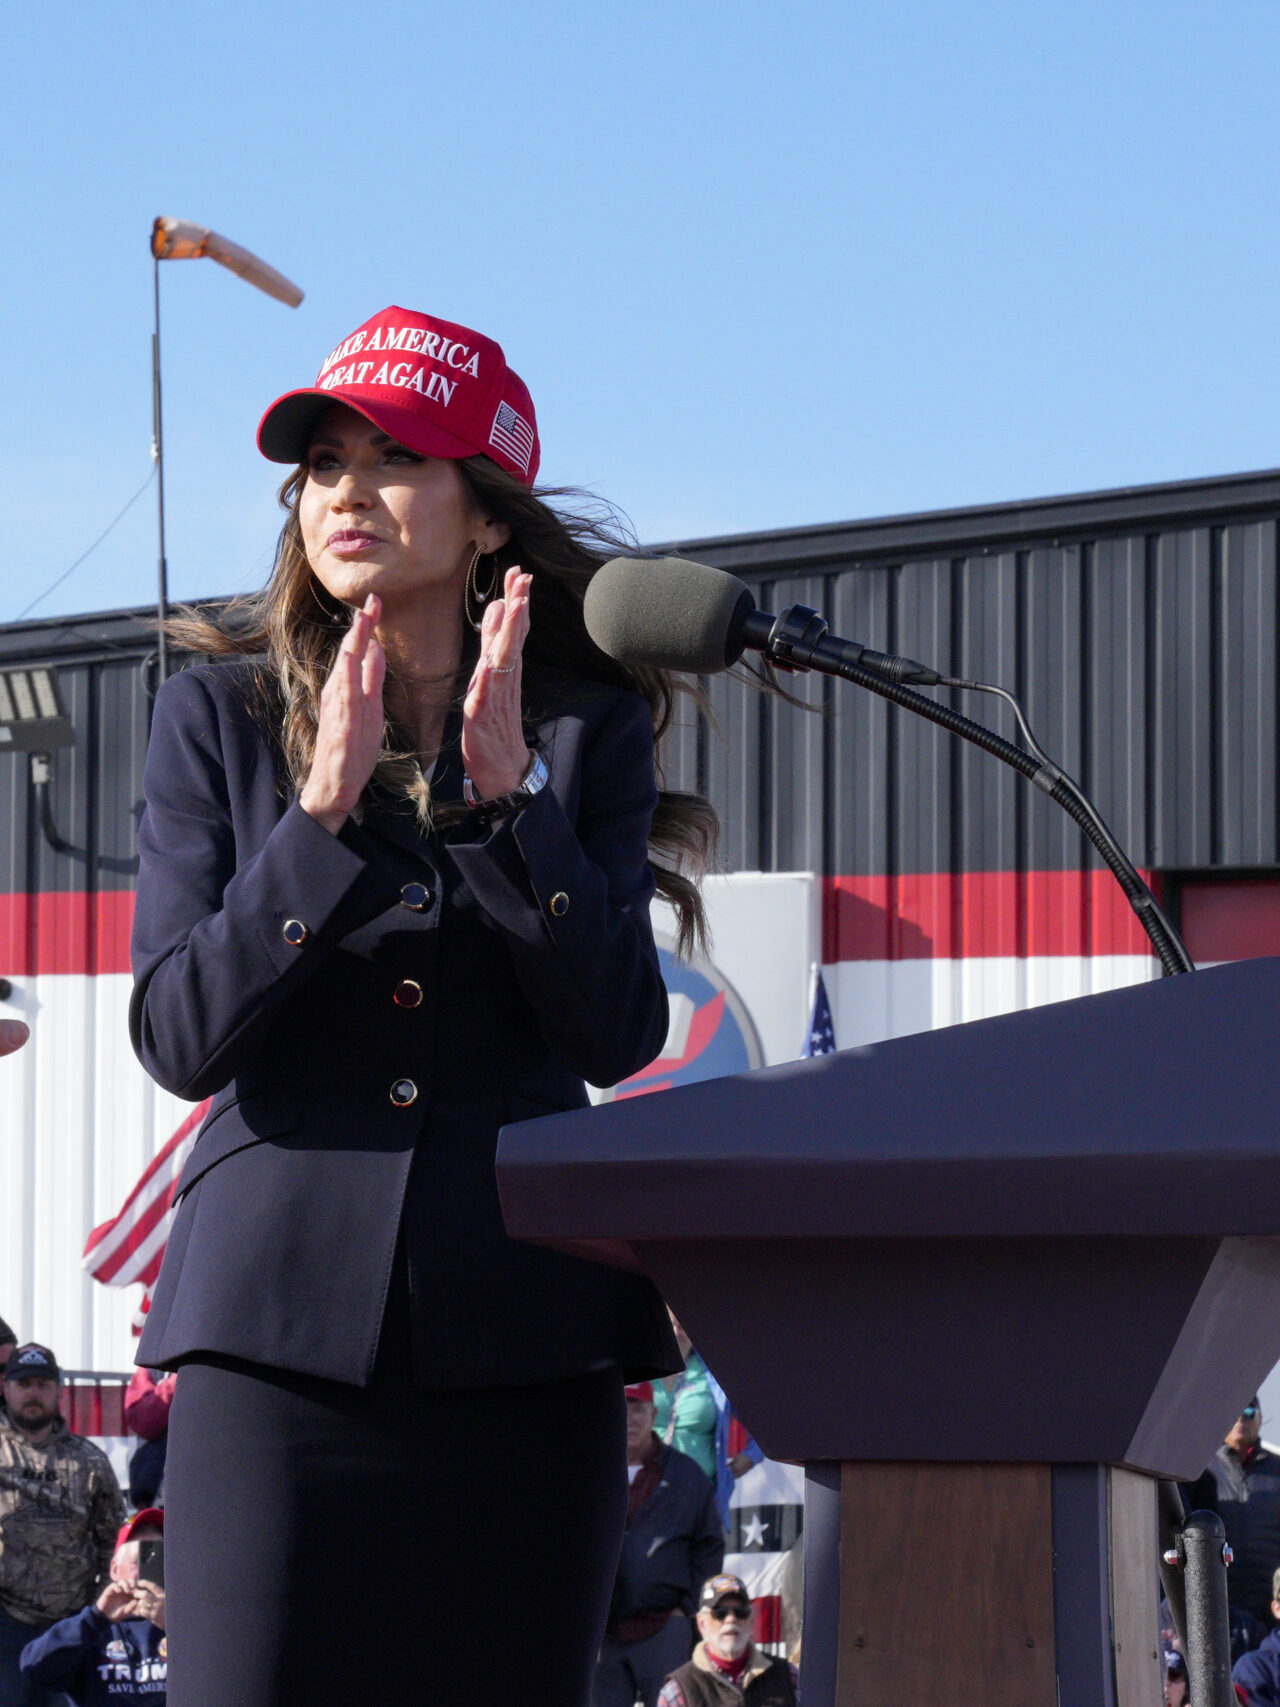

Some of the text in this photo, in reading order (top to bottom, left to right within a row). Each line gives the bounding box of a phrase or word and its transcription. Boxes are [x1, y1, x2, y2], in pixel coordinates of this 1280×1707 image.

[317, 326, 480, 382] MAKE AMERICA
[320, 361, 459, 408] REAT AGAIN
